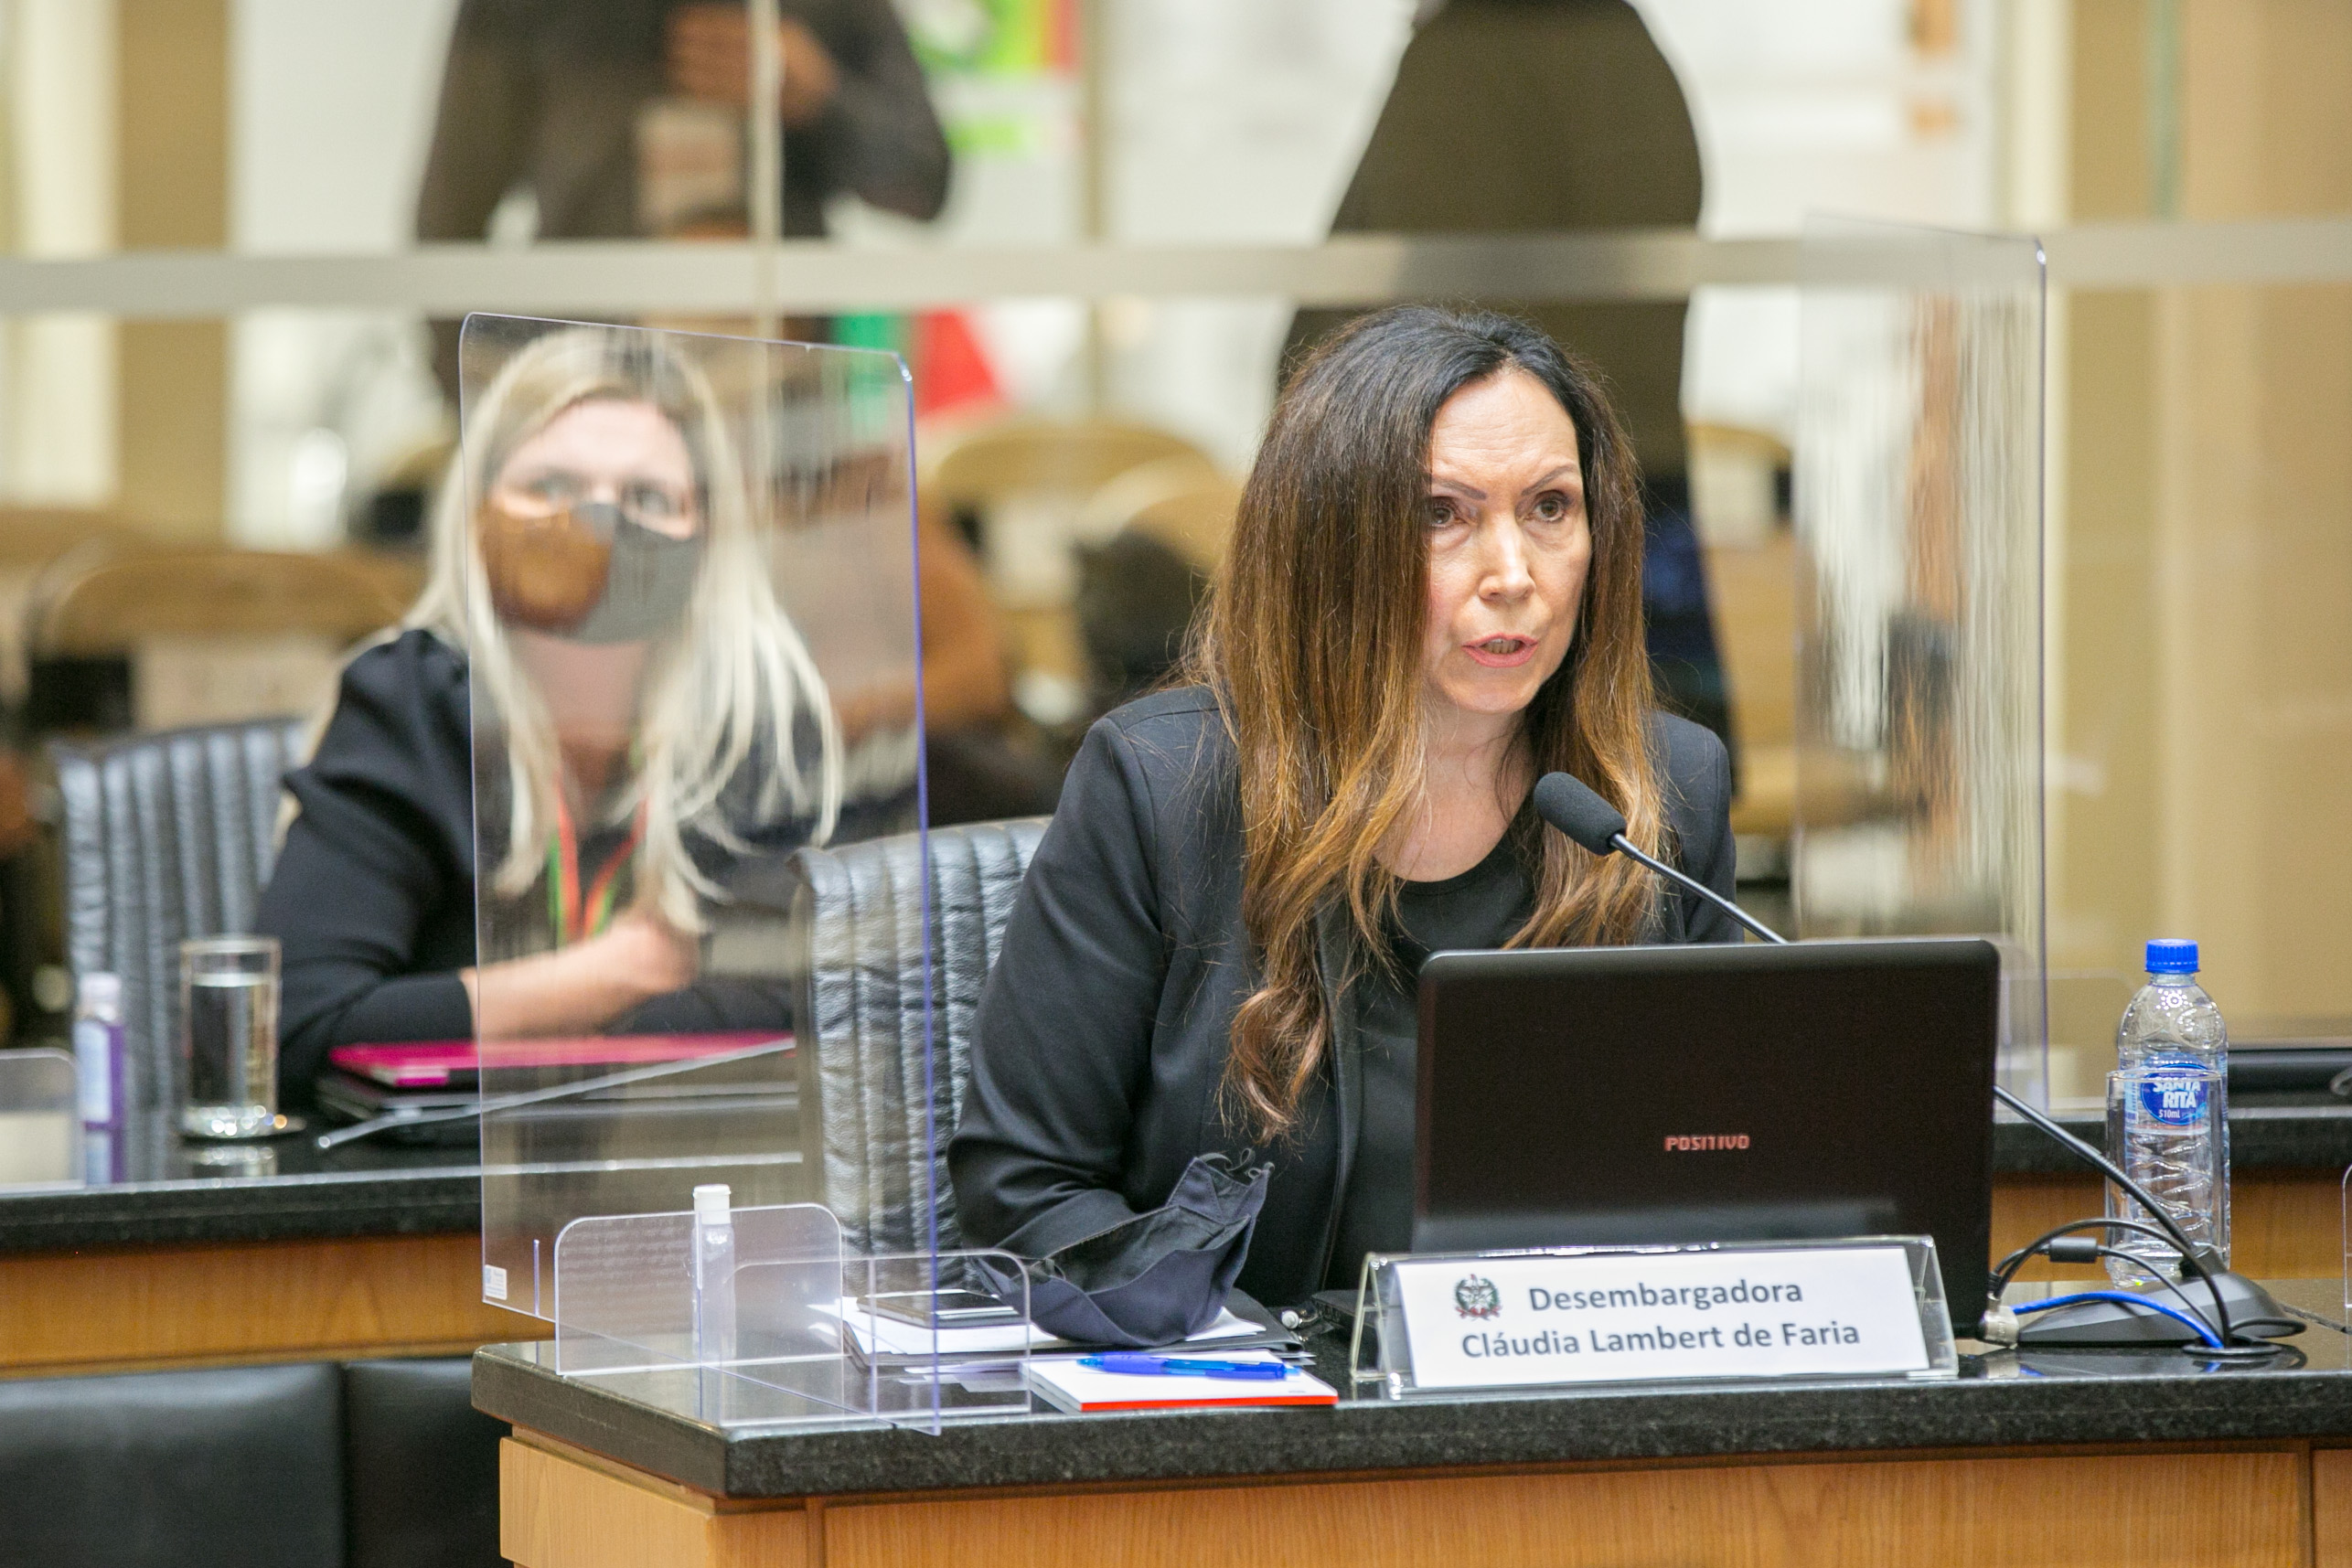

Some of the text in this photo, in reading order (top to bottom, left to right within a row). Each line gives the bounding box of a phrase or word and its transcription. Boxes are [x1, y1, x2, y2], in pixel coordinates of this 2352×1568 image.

[2153, 1078, 2201, 1093] SANTA
[2163, 1092, 2197, 1109] RITA
[1664, 1134, 1750, 1151] POSITIVO
[1529, 1278, 1802, 1311] Desembargadora
[1461, 1321, 1860, 1358] Cláudia Lambert de Faria
